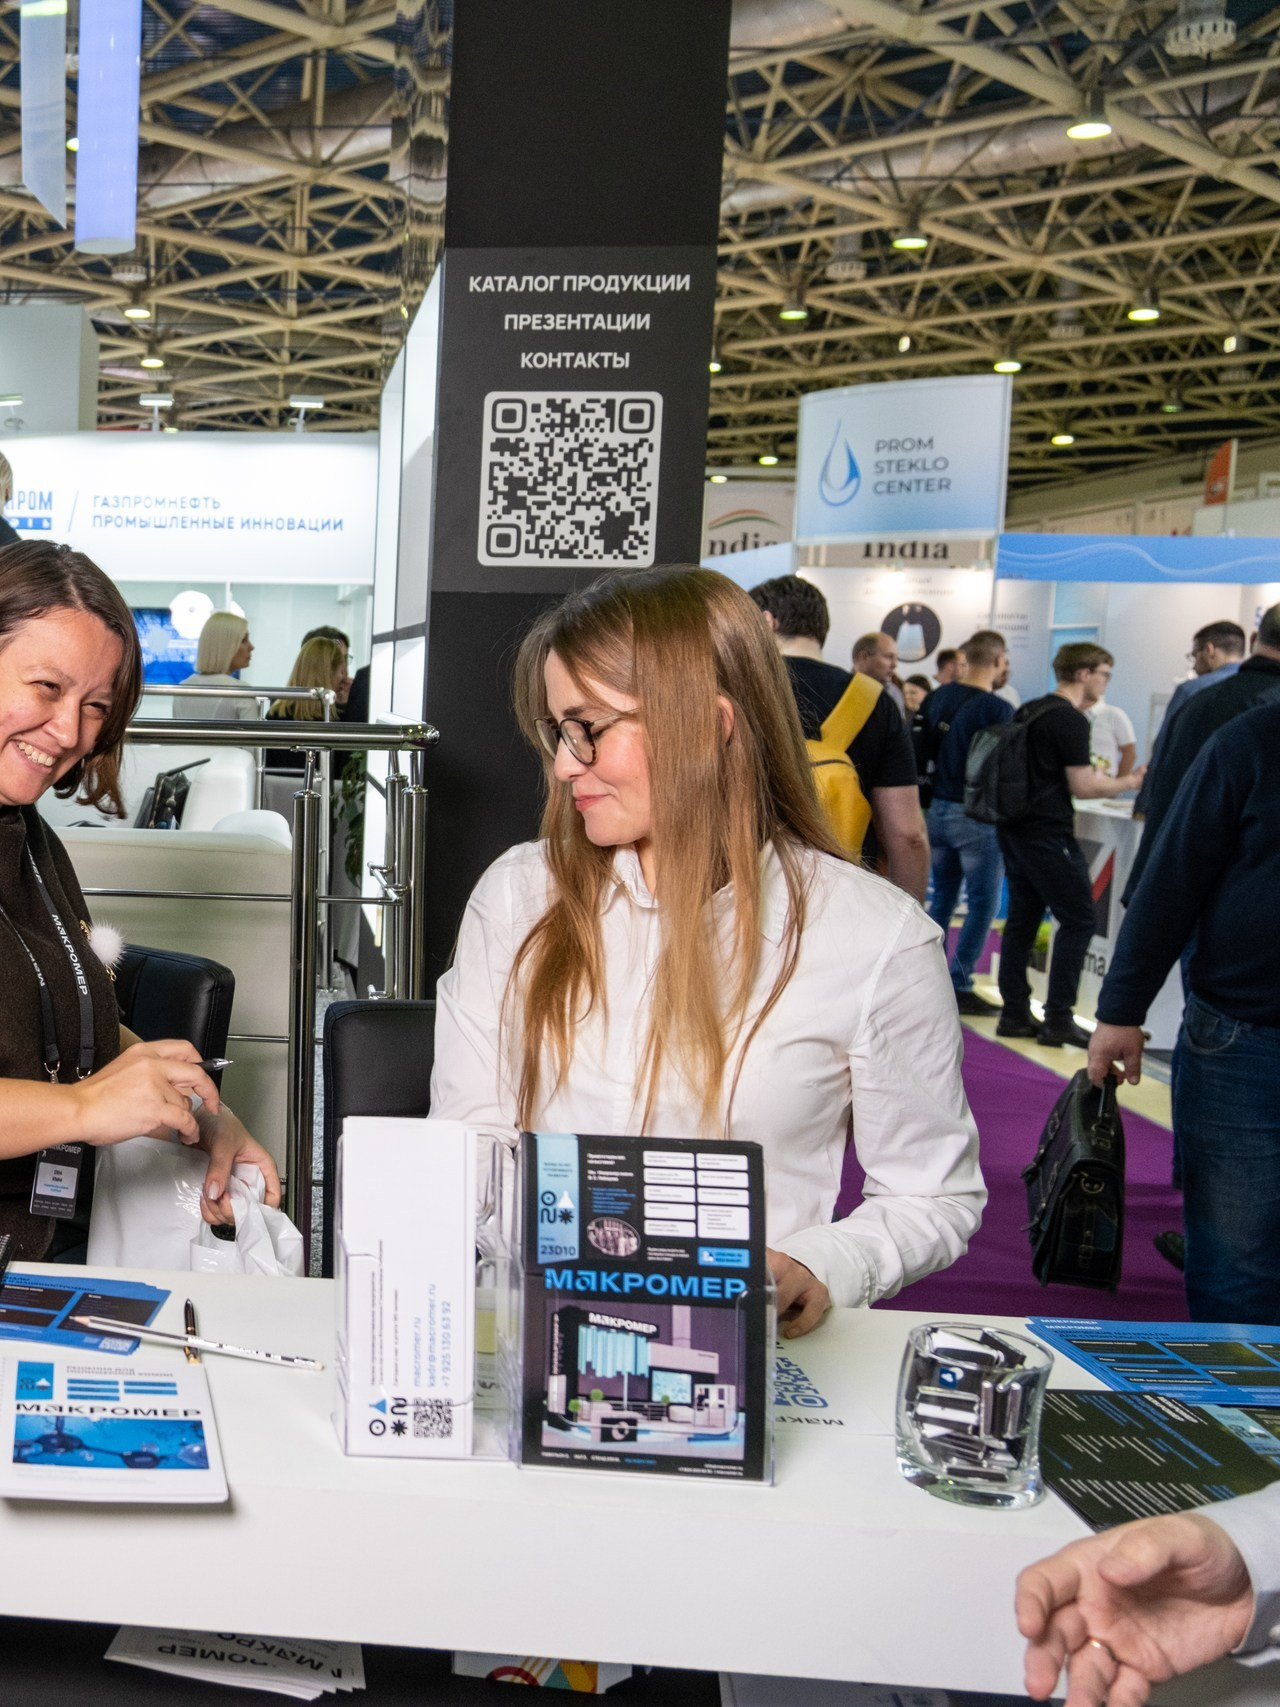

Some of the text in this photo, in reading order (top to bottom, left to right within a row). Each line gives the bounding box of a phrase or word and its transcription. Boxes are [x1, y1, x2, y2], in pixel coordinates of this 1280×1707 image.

[469, 274, 691, 294] КАТАЛОГ ПРОДУКЦИИ
[504, 313, 651, 332] ПРЕЗЕНТАЦИИ
[520, 352, 630, 369] КОНТАКТЫ
[874, 436, 934, 453] PROM
[874, 456, 950, 474] STEKLO
[873, 477, 952, 495] CENTER
[93, 494, 221, 510] ГАЗПРОМНЕФТЬ
[92, 514, 345, 532] ПРОМЫШЛЕННЫЕ ИННОВАЦИИ
[412, 1316, 421, 1388] macromer.ru
